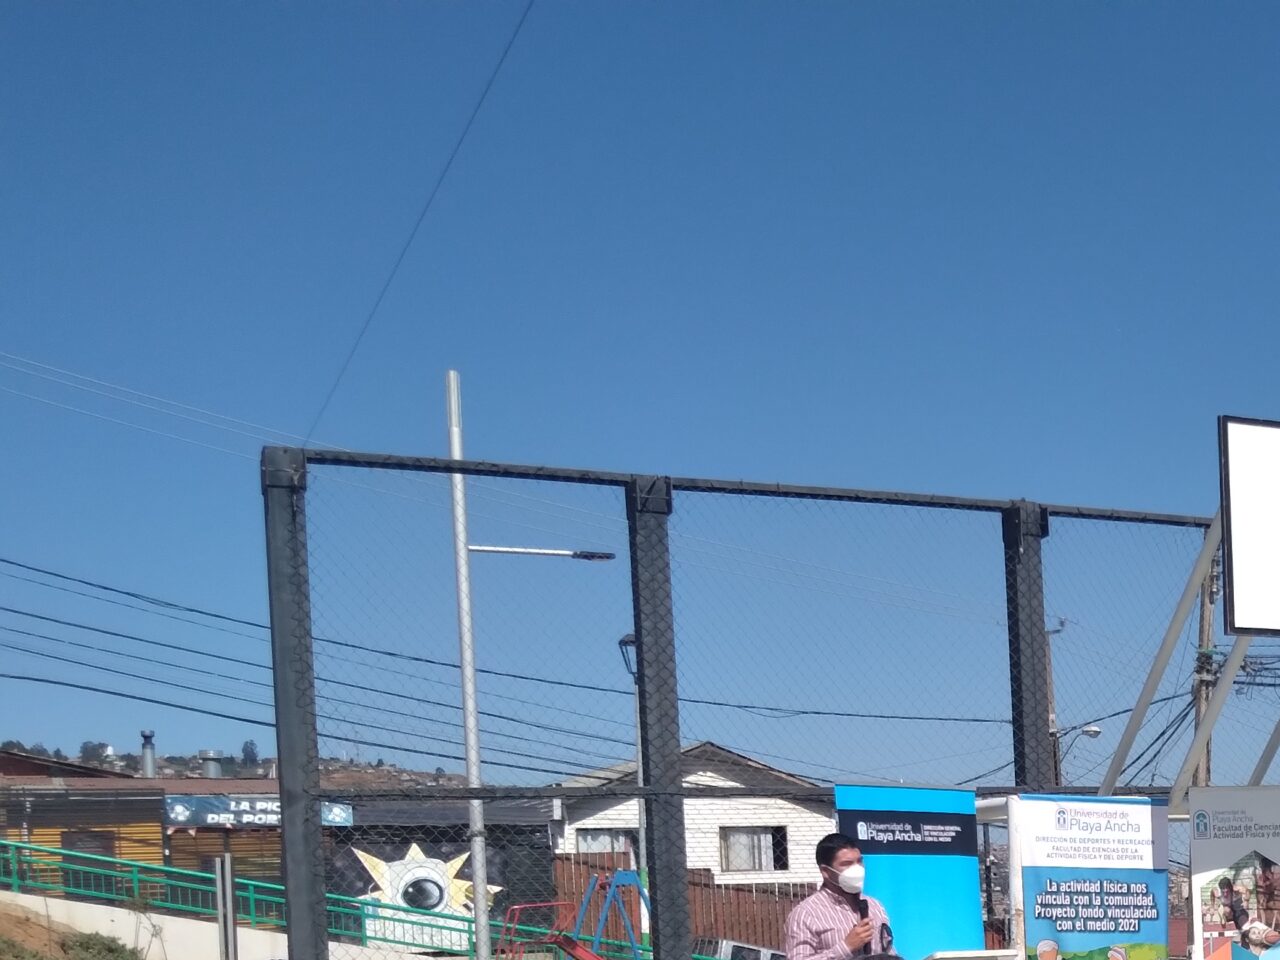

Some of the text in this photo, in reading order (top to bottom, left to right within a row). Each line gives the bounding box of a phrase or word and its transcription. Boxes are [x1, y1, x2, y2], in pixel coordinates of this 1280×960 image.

[230, 801, 250, 811] LA
[206, 814, 281, 824] DEL POR
[1070, 808, 1129, 819] Universidad de
[867, 822, 904, 831] Universidad
[1069, 818, 1140, 834] Playa Ancha
[1213, 824, 1242, 832] Facultad
[1243, 823, 1252, 831] de
[868, 830, 921, 843] Playa Ancha
[1213, 831, 1244, 839] Actividad
[1079, 837, 1111, 845] DEPORTES
[1047, 879, 1147, 893] La actividad física nos
[1036, 893, 1071, 905] vincula
[1073, 895, 1090, 906] con
[1092, 894, 1101, 906] la
[1035, 905, 1158, 919] Proyecto fondo vinculación
[1056, 919, 1139, 931] con el medio 2021
